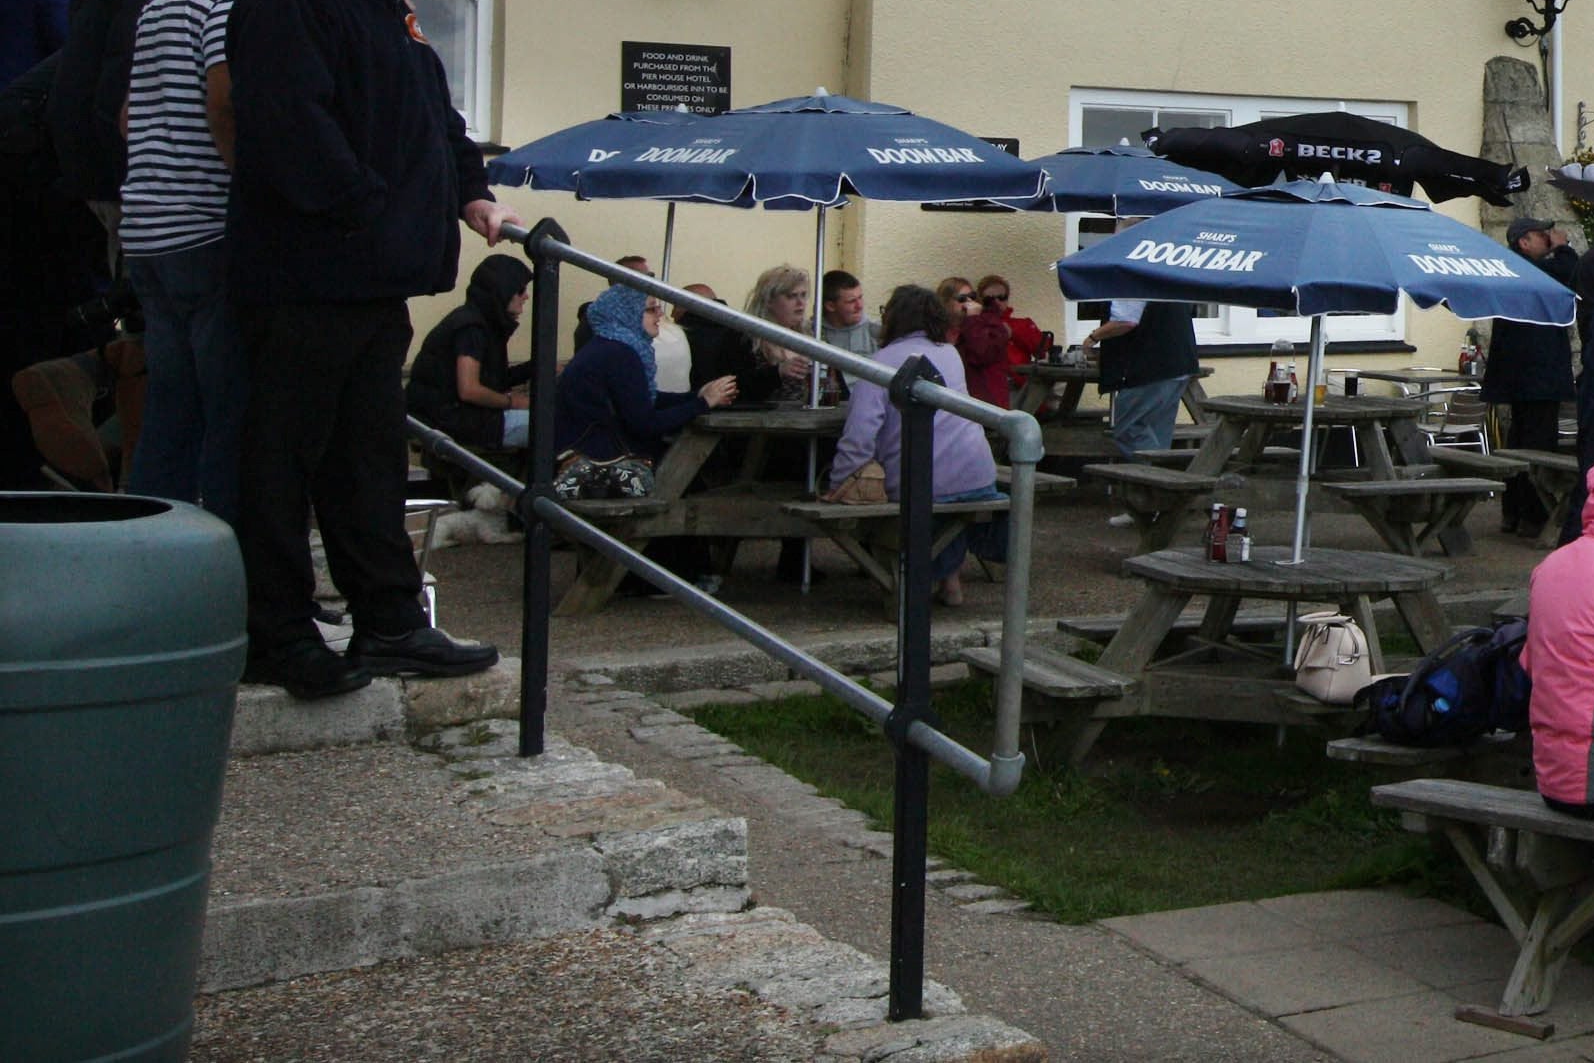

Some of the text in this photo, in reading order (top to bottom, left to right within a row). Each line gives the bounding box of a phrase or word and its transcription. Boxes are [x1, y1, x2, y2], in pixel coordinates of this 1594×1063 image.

[642, 52, 709, 62] FOOD AND DRINK
[633, 62, 678, 71] PURCHASED
[680, 63, 701, 72] FROM
[659, 73, 685, 81] HOUSE
[686, 75, 711, 83] HOTEL
[624, 82, 635, 90] OR
[637, 83, 689, 92] HARBOURSIDE
[646, 93, 704, 103] CONSUMED ON
[637, 103, 659, 111] THESE
[695, 106, 716, 114] ONLY
[633, 146, 699, 164] DOOM
[689, 148, 736, 164] BAR
[866, 147, 985, 165] DOOM BAR
[1138, 179, 1223, 198] DOOM BAR
[1126, 240, 1264, 272] DOOM BAR
[1407, 254, 1520, 278] DOOM BAR
